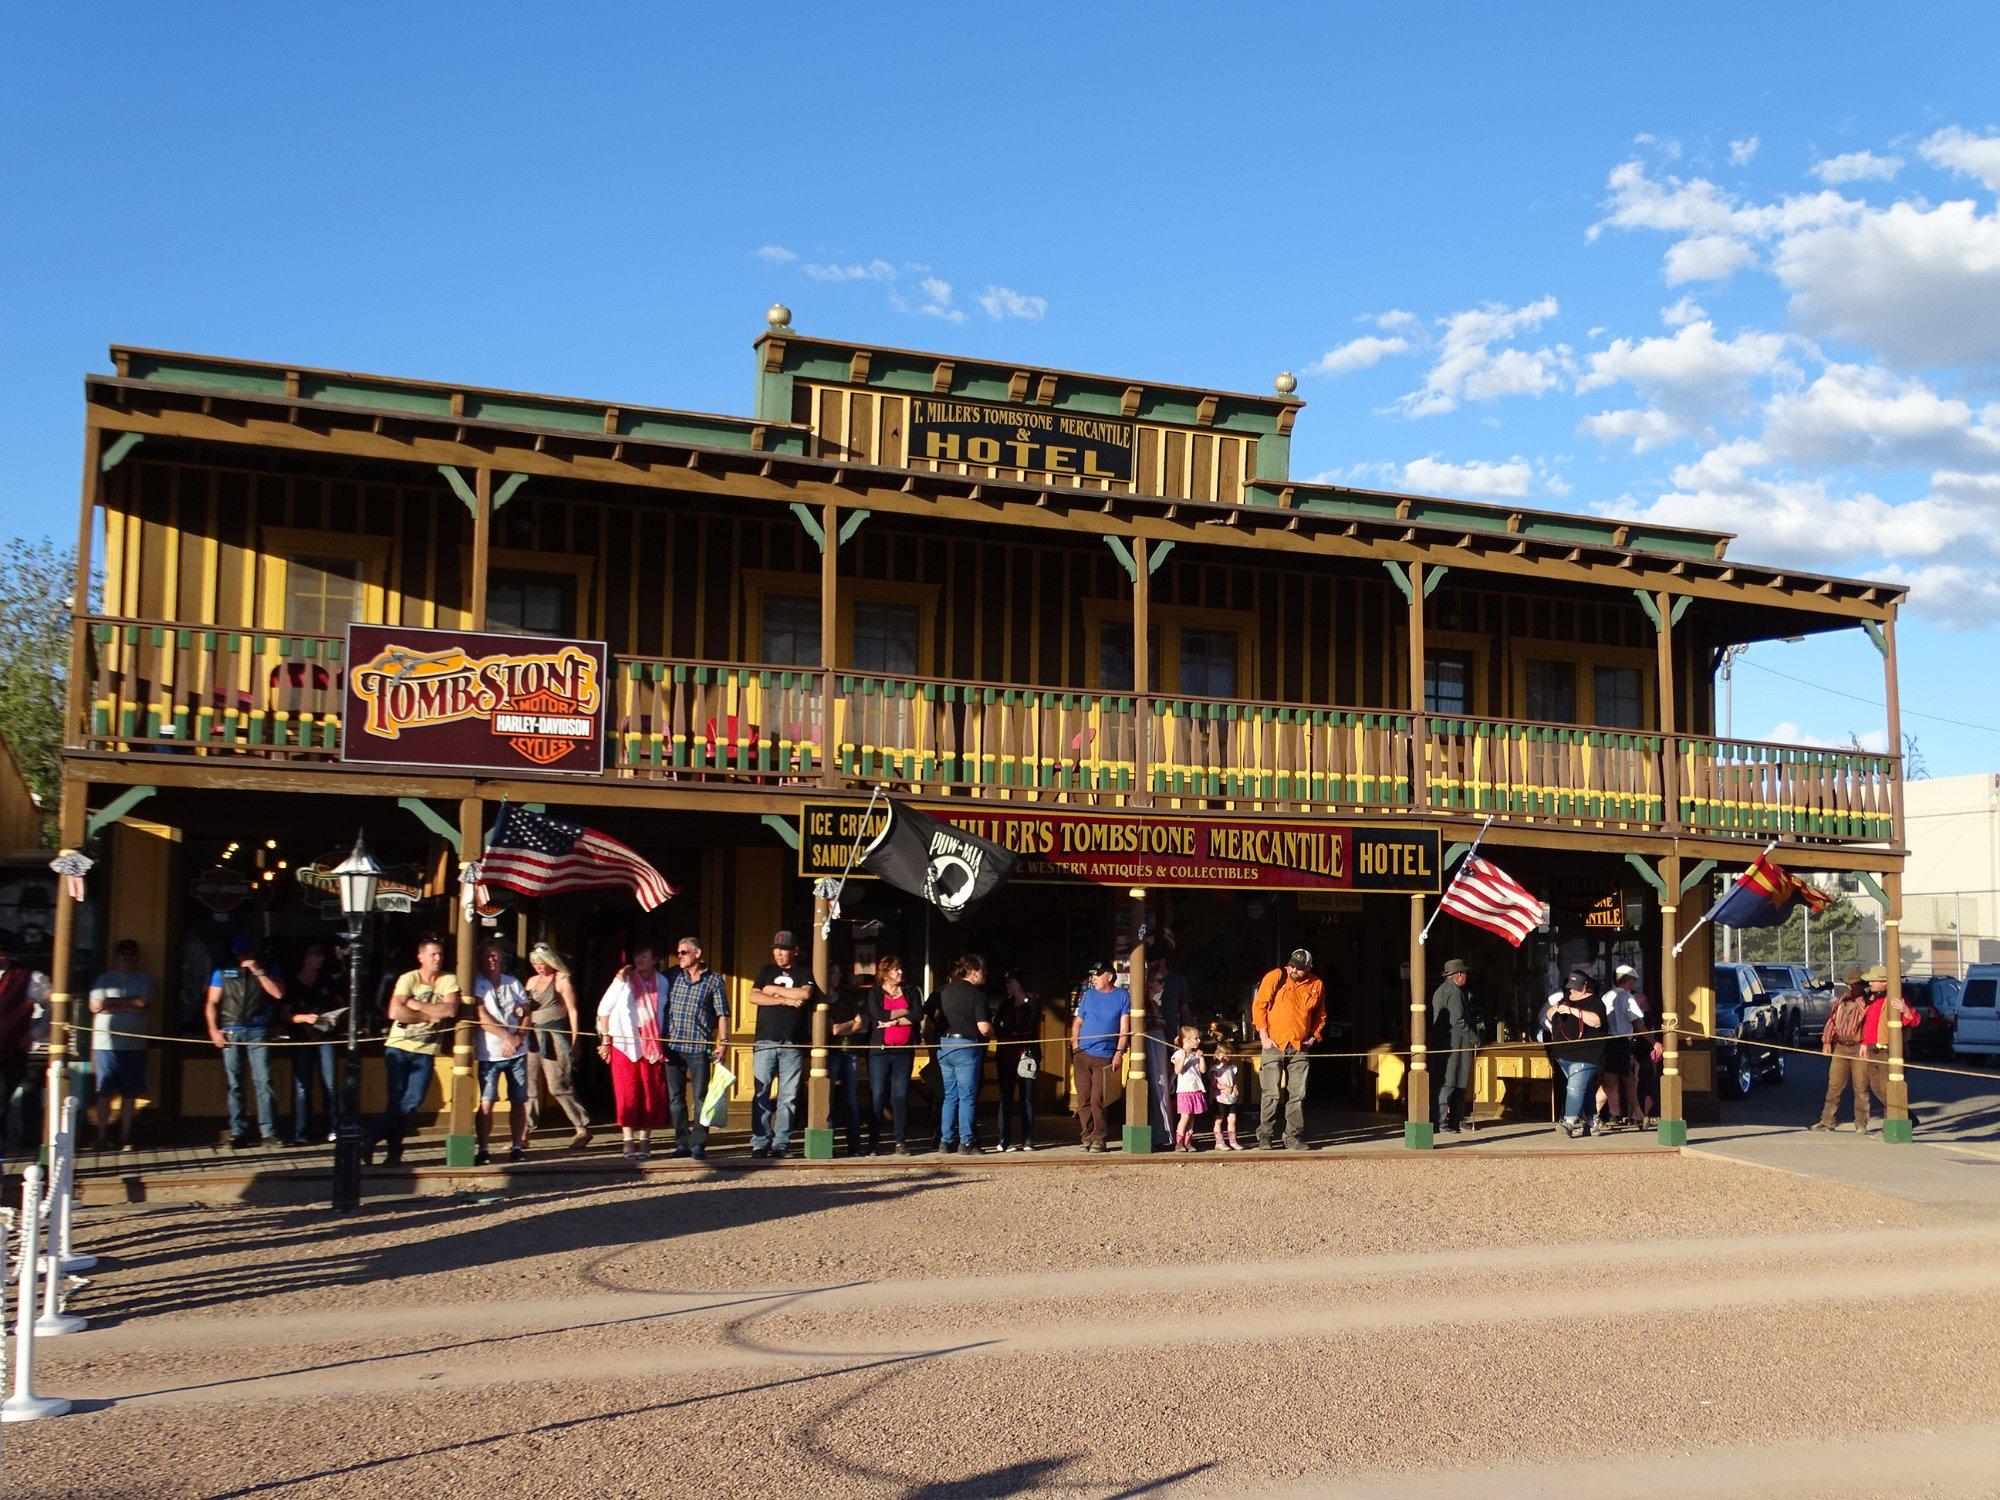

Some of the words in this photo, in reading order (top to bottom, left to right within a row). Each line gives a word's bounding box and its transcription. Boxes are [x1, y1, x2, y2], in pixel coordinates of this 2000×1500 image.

[914, 401, 924, 423] T.
[927, 401, 980, 424] MILLER'S
[984, 408, 1053, 431] TOMBSTONE
[1059, 418, 1131, 448] MERCANTILE
[1016, 428, 1031, 442] &
[926, 431, 1115, 478] HOTEL
[360, 654, 594, 734] TOMBSTONE
[520, 693, 569, 714] MOTOR
[496, 715, 590, 736] HARLEY-DAVIDSON
[517, 738, 567, 760] CYCLES
[811, 812, 834, 836] ICE
[840, 813, 887, 837] CREAM
[949, 819, 1054, 853] LER'S
[1060, 822, 1196, 855] TOMBSTONE
[1210, 827, 1344, 878] MERCANTILE
[1360, 842, 1431, 876] HOTEL
[1028, 861, 1087, 875] WESTERN
[1091, 863, 1152, 877] ANTIQUES
[1156, 865, 1167, 877] &
[1169, 866, 1259, 880] COLLECTIBLES
